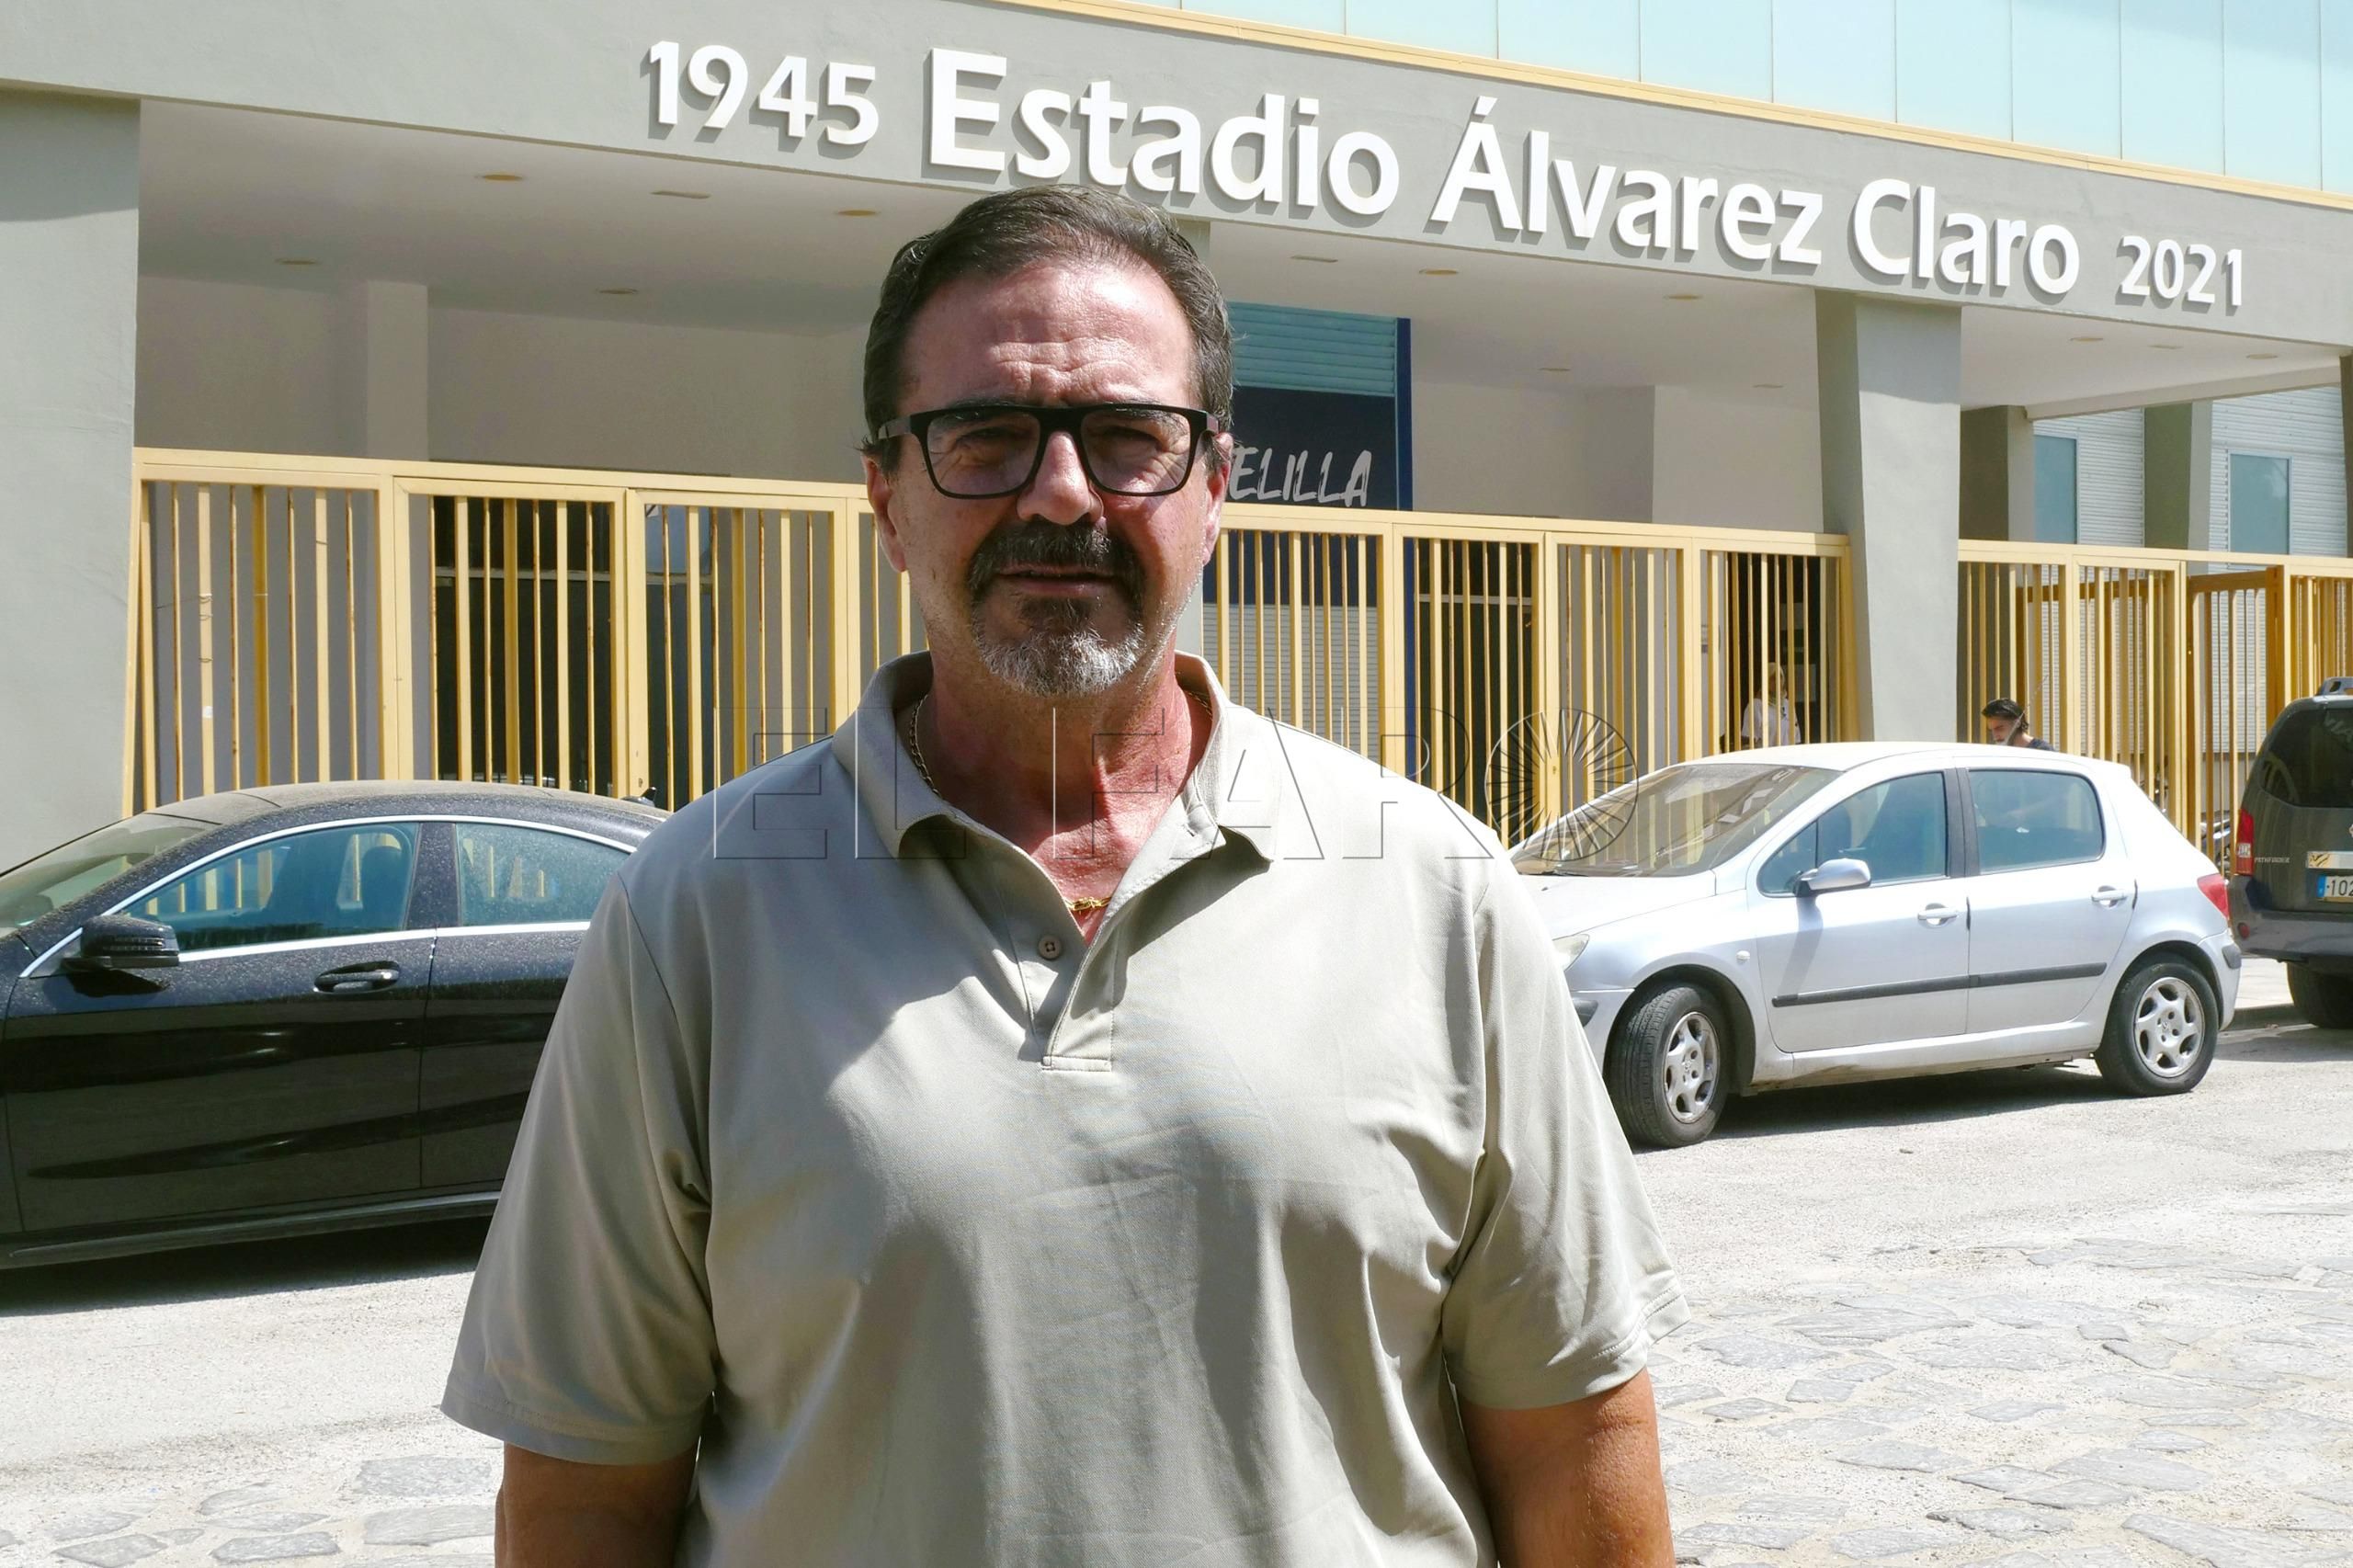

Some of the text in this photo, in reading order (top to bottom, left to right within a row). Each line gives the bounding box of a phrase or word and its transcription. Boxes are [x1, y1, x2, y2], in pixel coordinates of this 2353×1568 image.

[649, 40, 2244, 306] 1945 Estadio Álvarez Claro 2021
[1229, 446, 1372, 507] ELILLA
